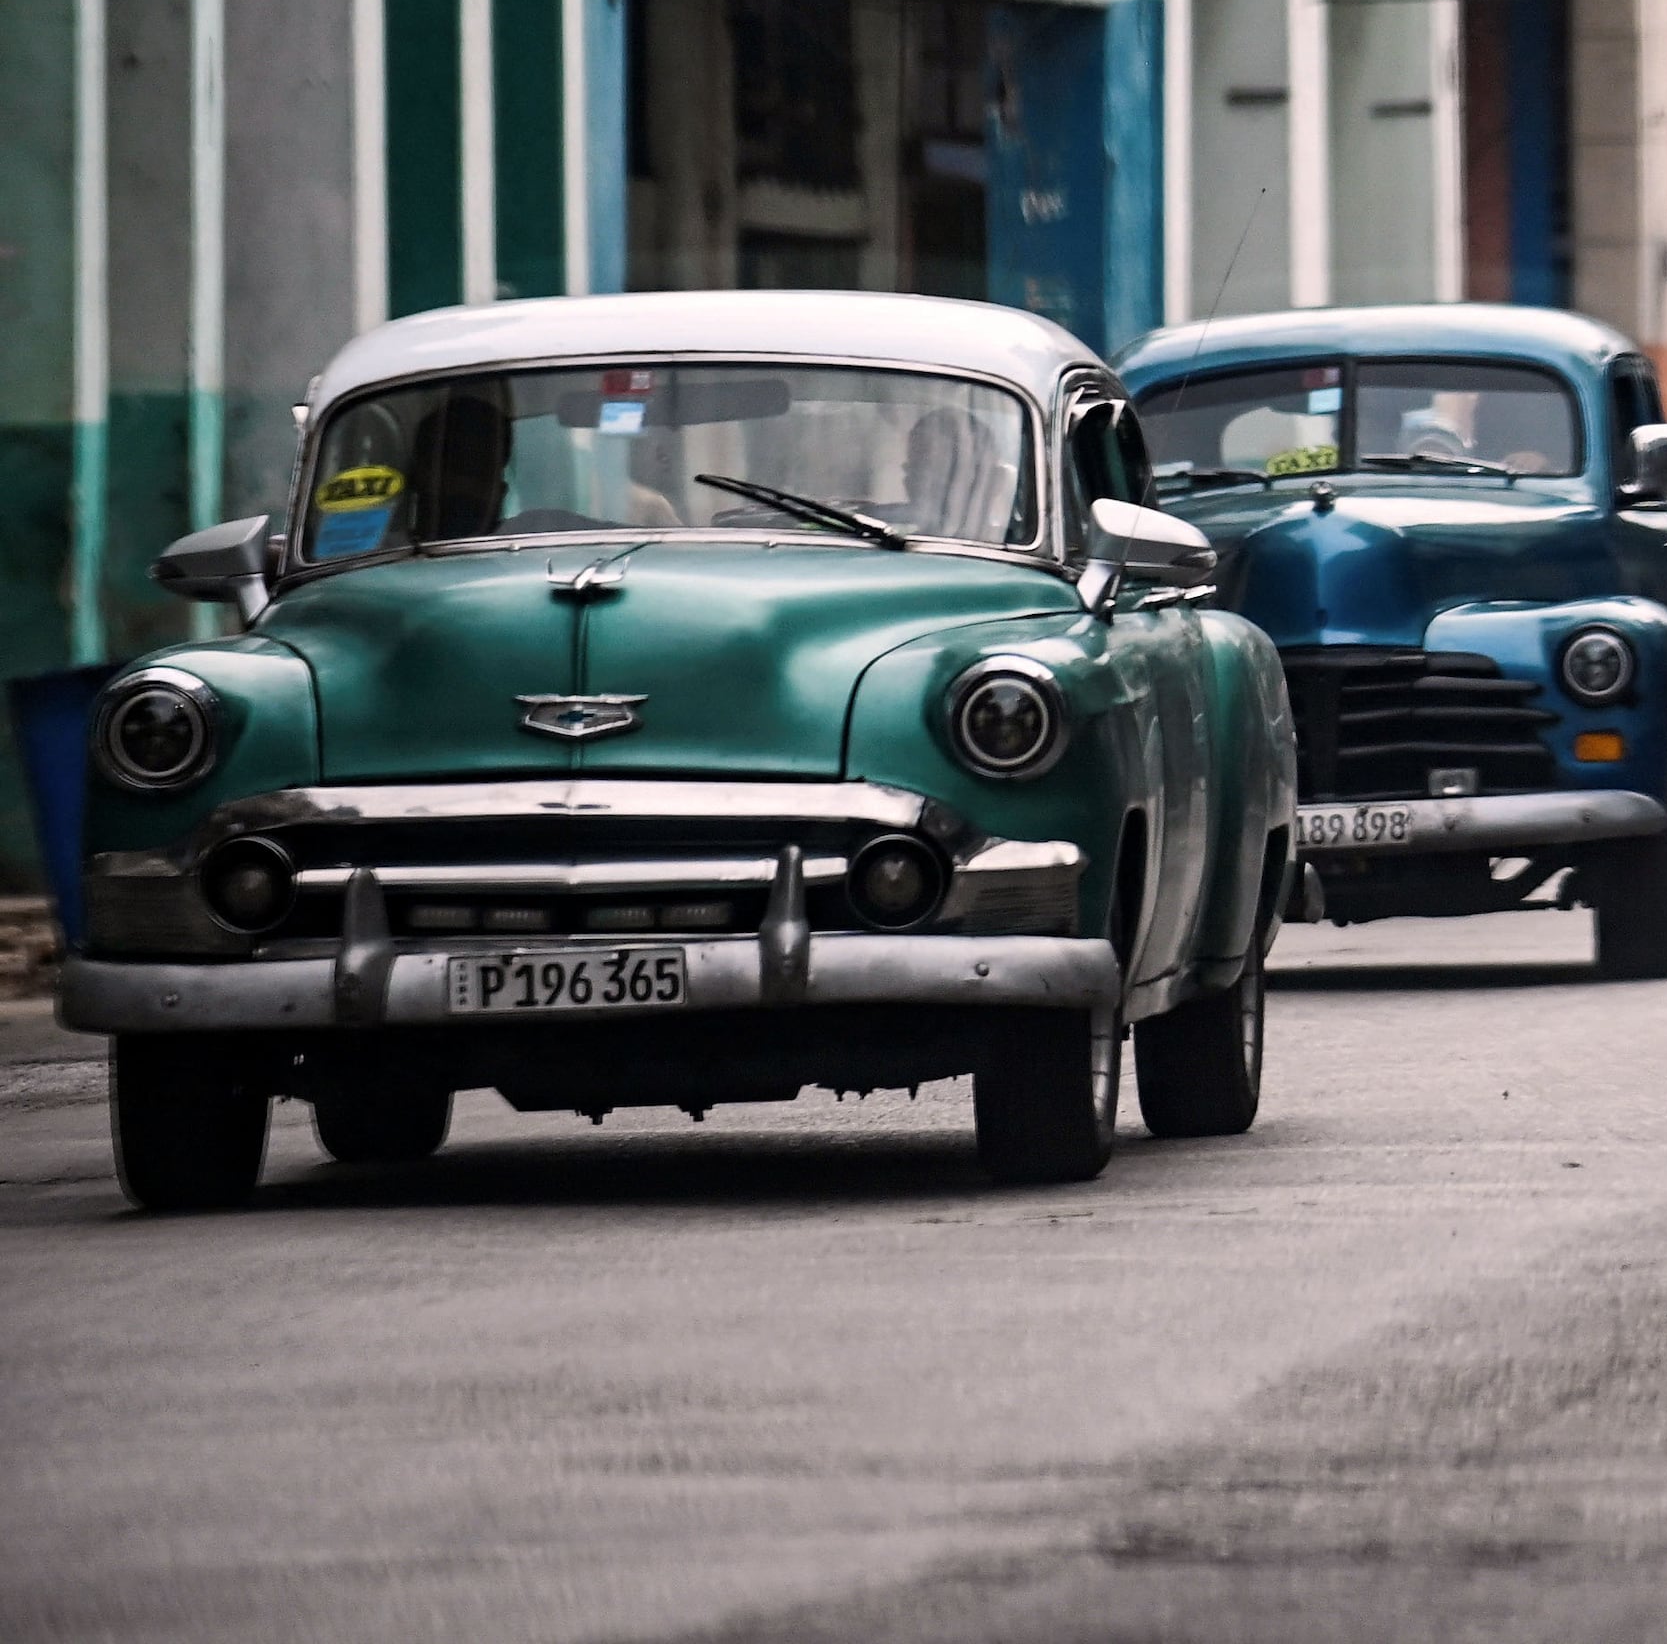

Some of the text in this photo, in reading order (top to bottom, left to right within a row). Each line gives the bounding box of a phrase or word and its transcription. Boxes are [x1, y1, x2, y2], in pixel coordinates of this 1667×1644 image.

[323, 474, 396, 502] TAXI
[1352, 808, 1406, 842] 898
[602, 956, 680, 1003] 365
